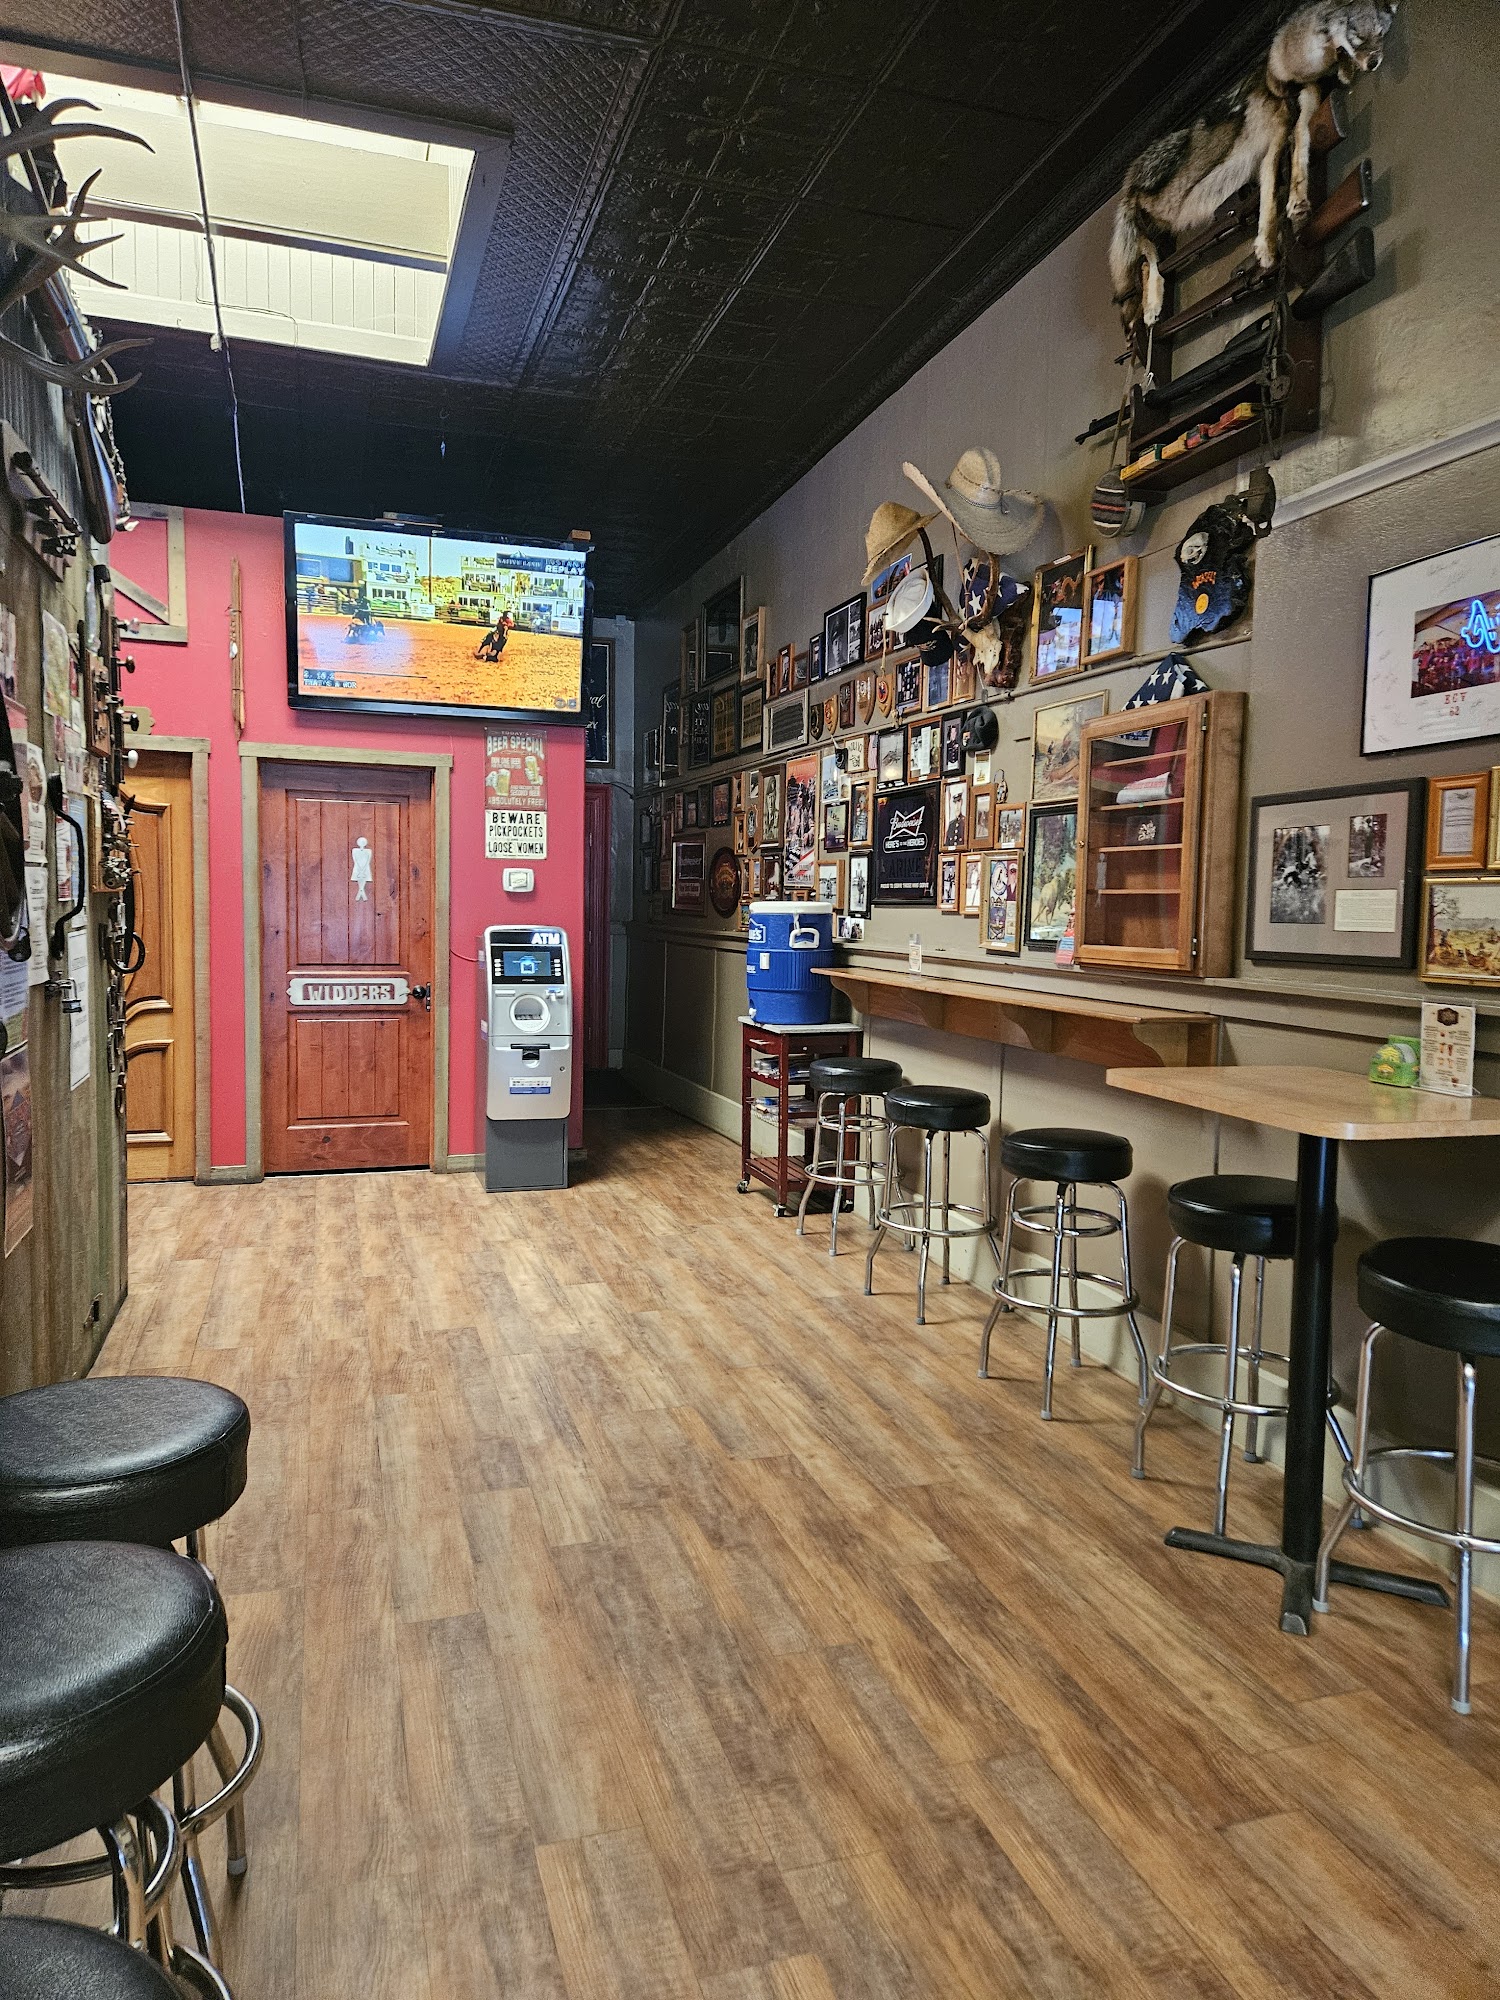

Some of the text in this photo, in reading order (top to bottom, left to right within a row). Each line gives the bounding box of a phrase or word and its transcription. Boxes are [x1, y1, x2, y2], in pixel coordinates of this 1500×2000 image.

[545, 564, 586, 575] REPLAY
[487, 736, 545, 760] BEER SPECIAL
[488, 797, 526, 806] ABSOLUTELY
[493, 813, 541, 825] BEWARE
[489, 825, 543, 838] PICKPOCKETS
[488, 841, 544, 854] LOOSE WOMEN
[531, 932, 561, 945] ATM
[307, 985, 391, 1001] WIDDERS
